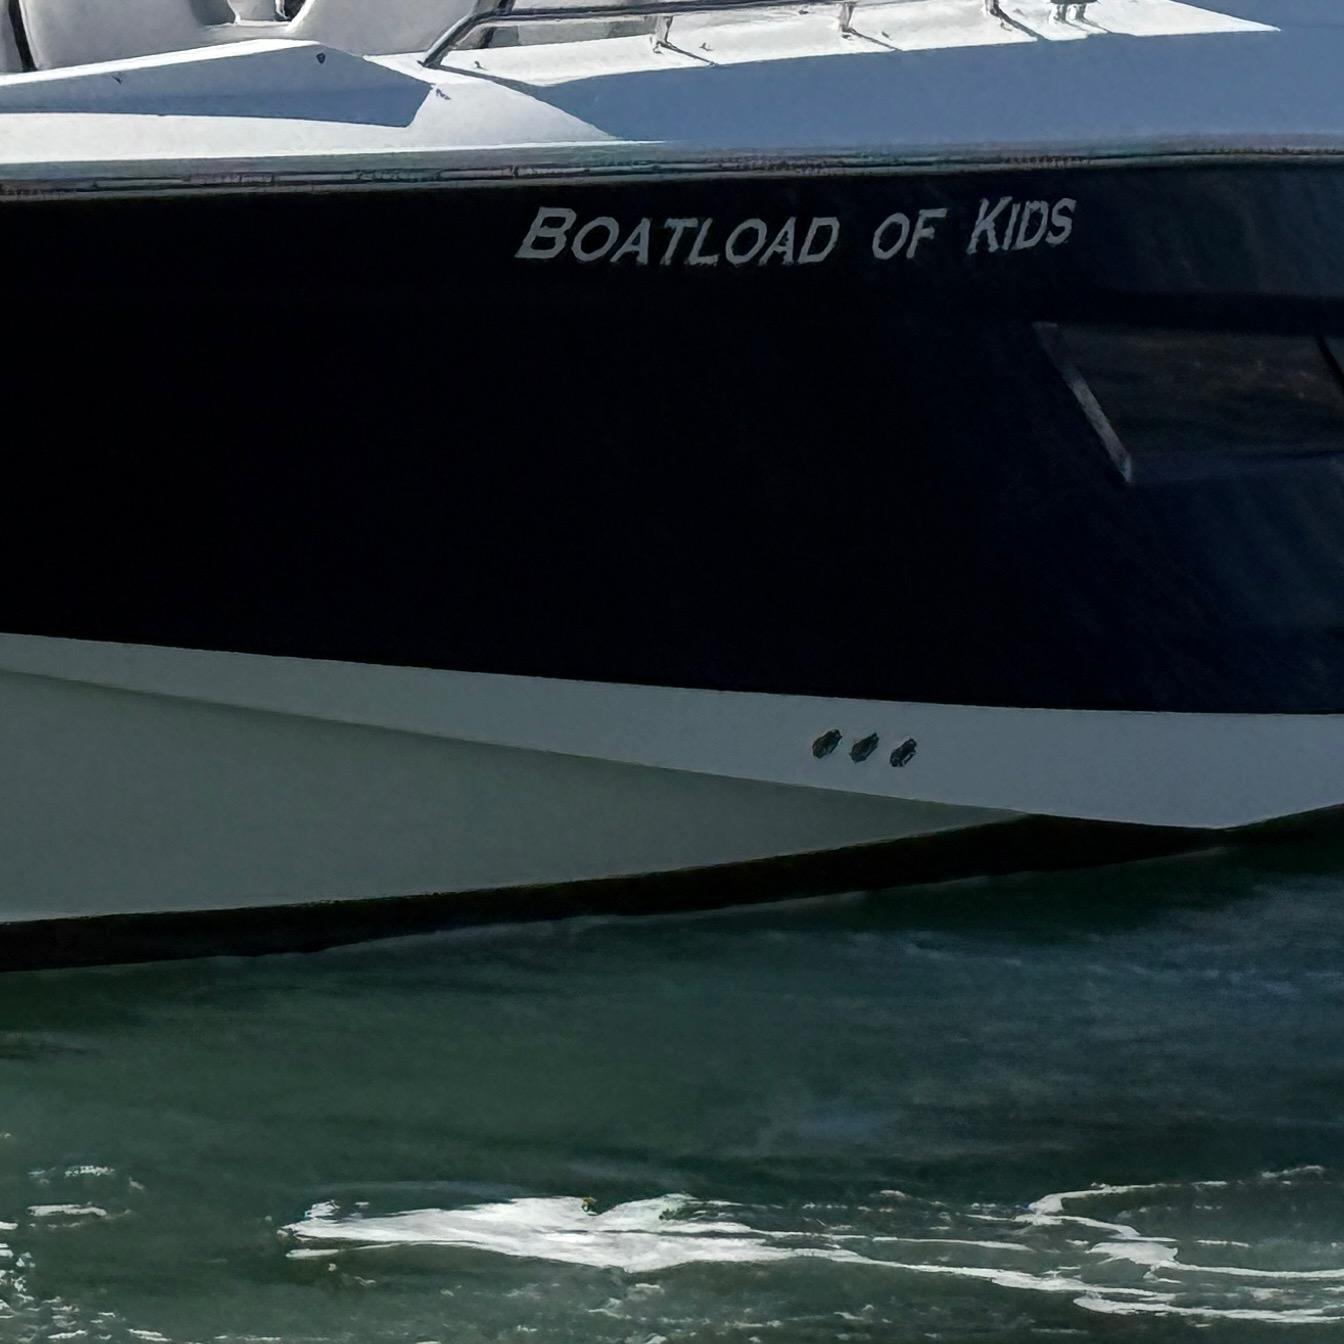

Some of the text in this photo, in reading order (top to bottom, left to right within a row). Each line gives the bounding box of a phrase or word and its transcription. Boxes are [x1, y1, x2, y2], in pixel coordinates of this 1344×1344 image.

[515, 196, 1077, 266] BOATLOAD OF KIDS
